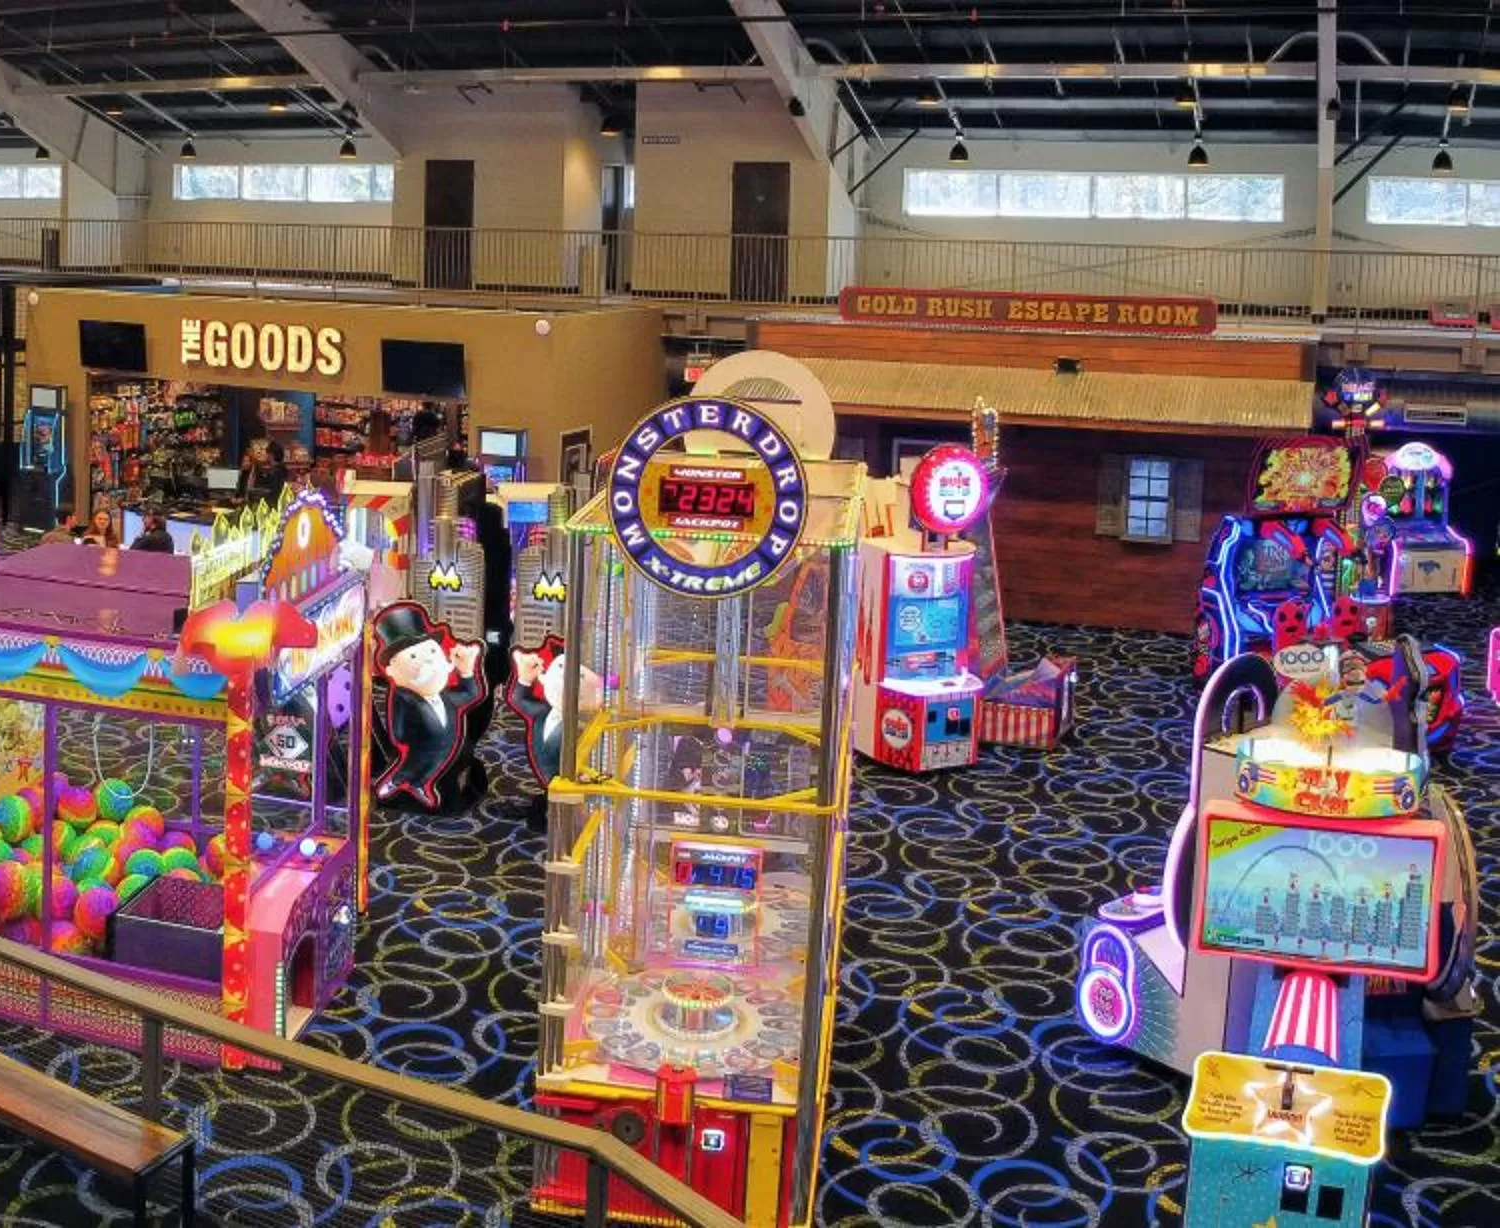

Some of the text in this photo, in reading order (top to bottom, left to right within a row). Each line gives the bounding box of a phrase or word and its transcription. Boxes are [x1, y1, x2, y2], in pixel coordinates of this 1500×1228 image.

[855, 295, 1201, 327] GOLD RUSH ESCAPE ROOM
[181, 319, 343, 376] THE GOODS
[673, 467, 743, 480] MONSTER
[674, 517, 740, 530] JACKPOT
[643, 555, 763, 592] X-TREME
[1307, 831, 1379, 860] 1000
